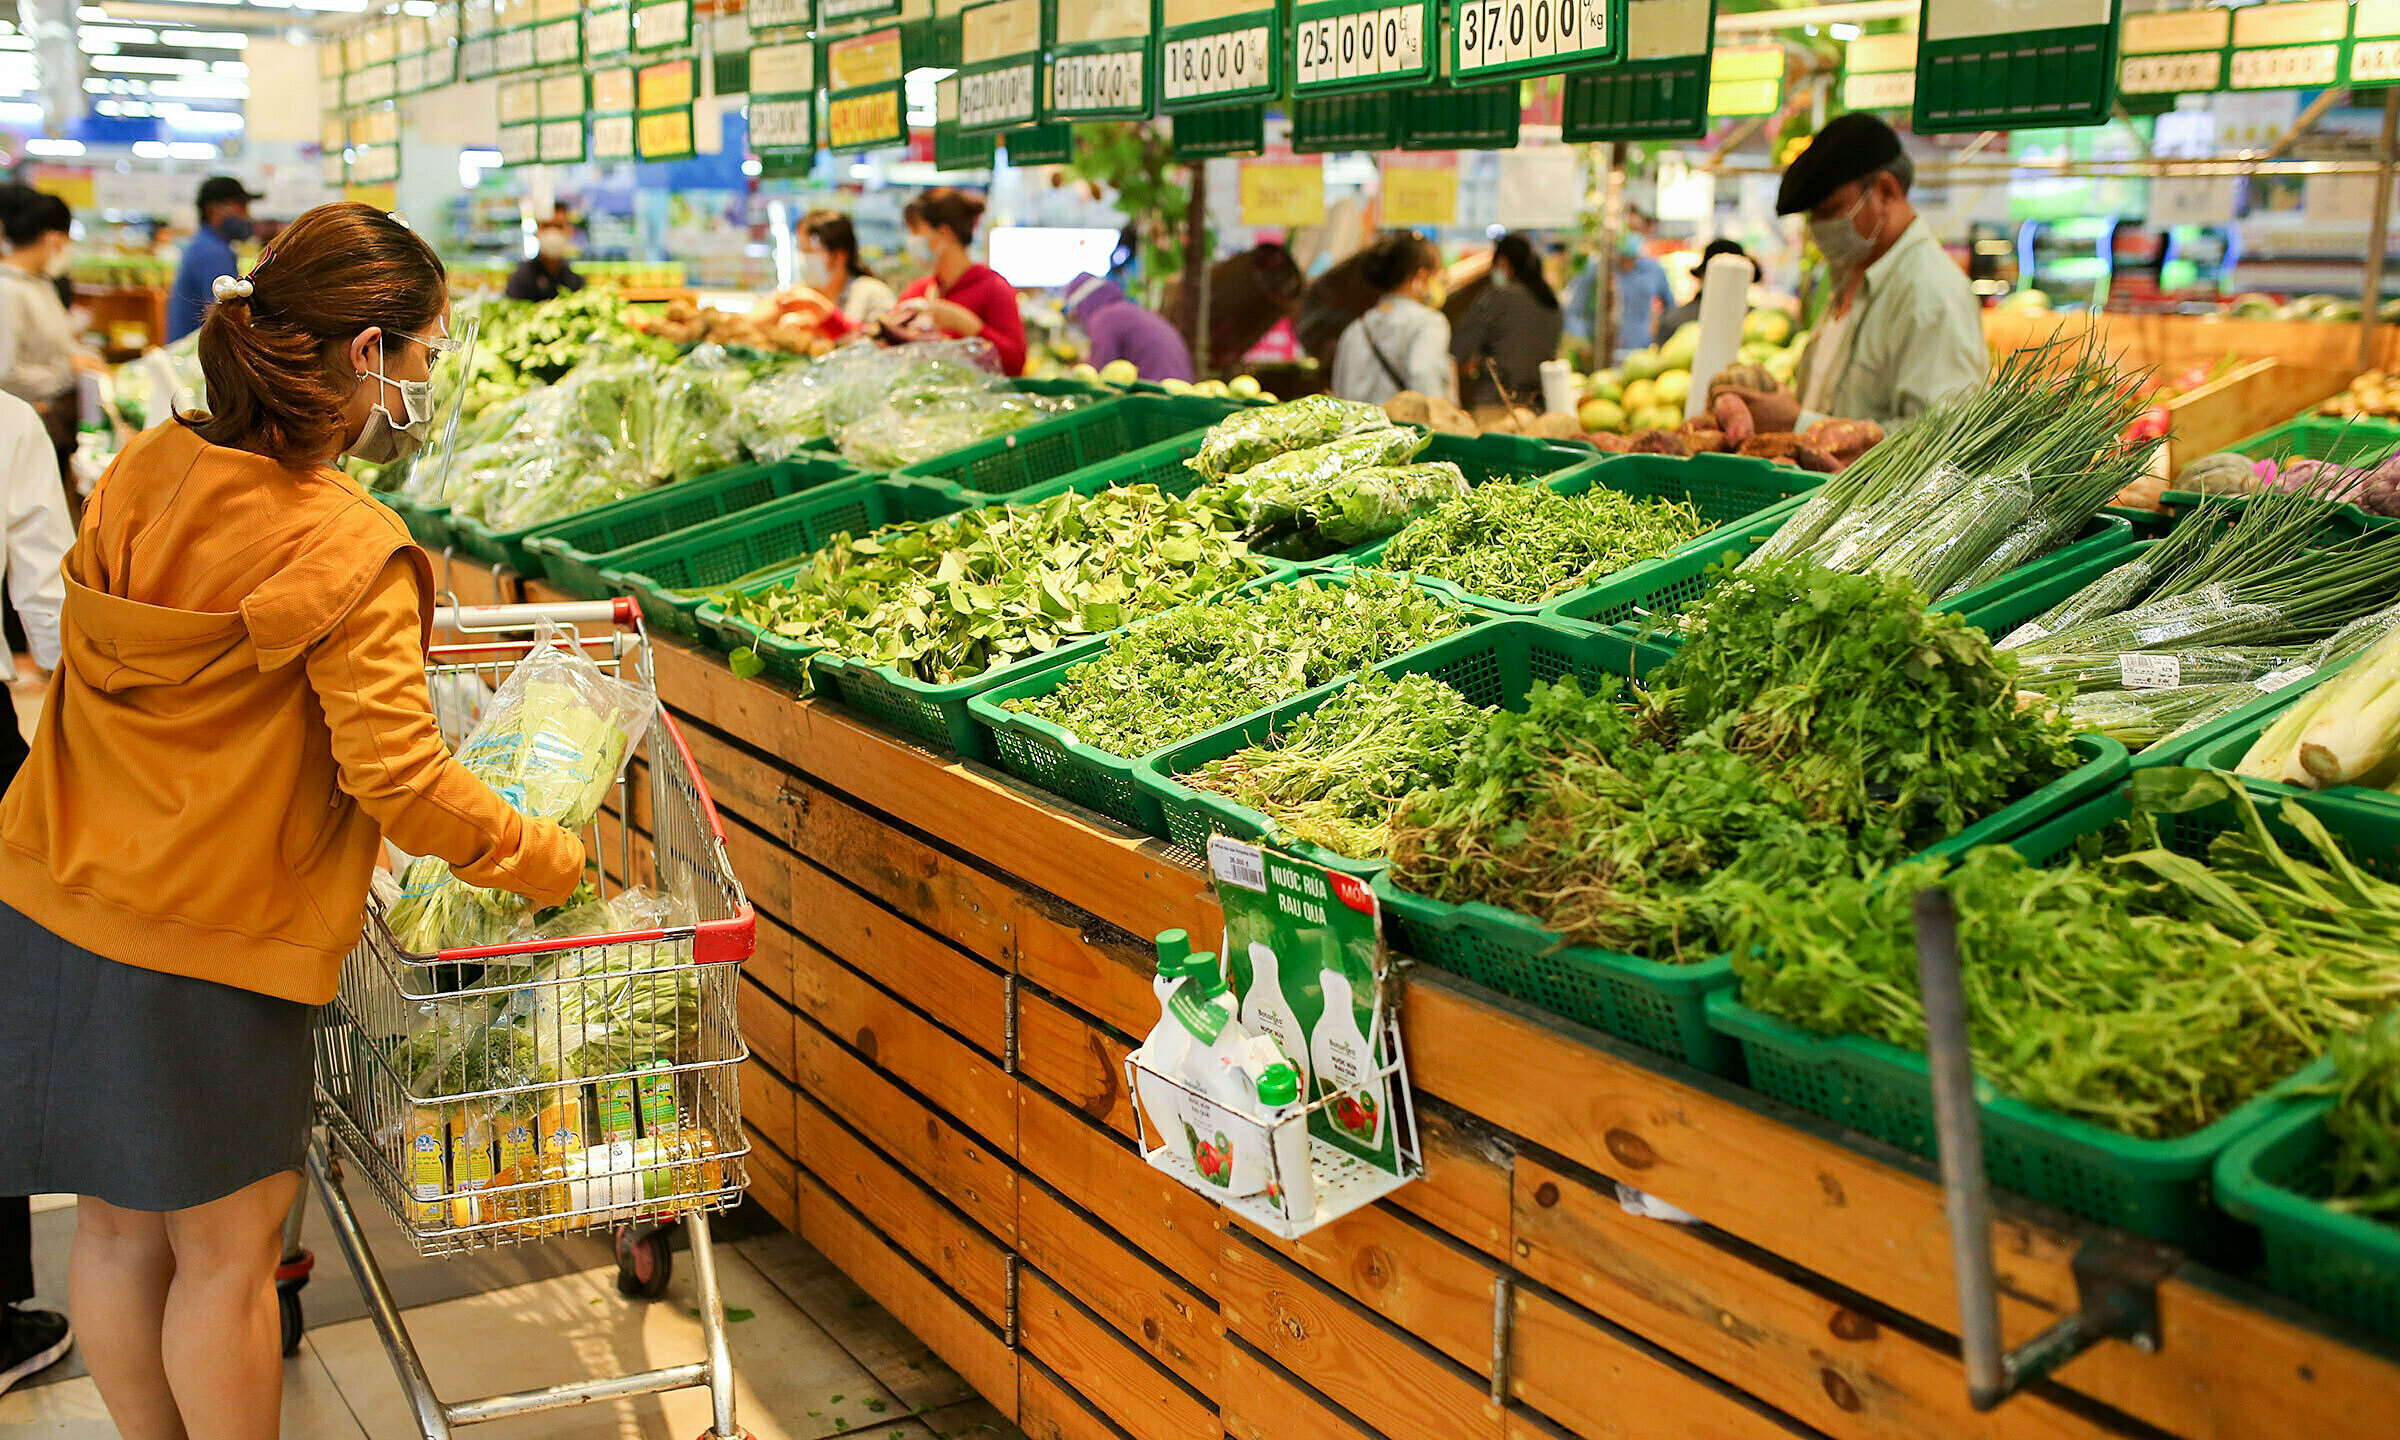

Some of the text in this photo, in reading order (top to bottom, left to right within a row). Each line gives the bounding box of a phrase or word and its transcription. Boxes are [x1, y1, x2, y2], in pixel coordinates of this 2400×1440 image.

[1303, 18, 1396, 67] 25.000
[1465, 0, 1574, 50] 37.000
[1171, 40, 1244, 82] 18.000
[1271, 865, 1328, 900] NƯỚC RỬA
[1278, 893, 1328, 926] RAU QUẢ
